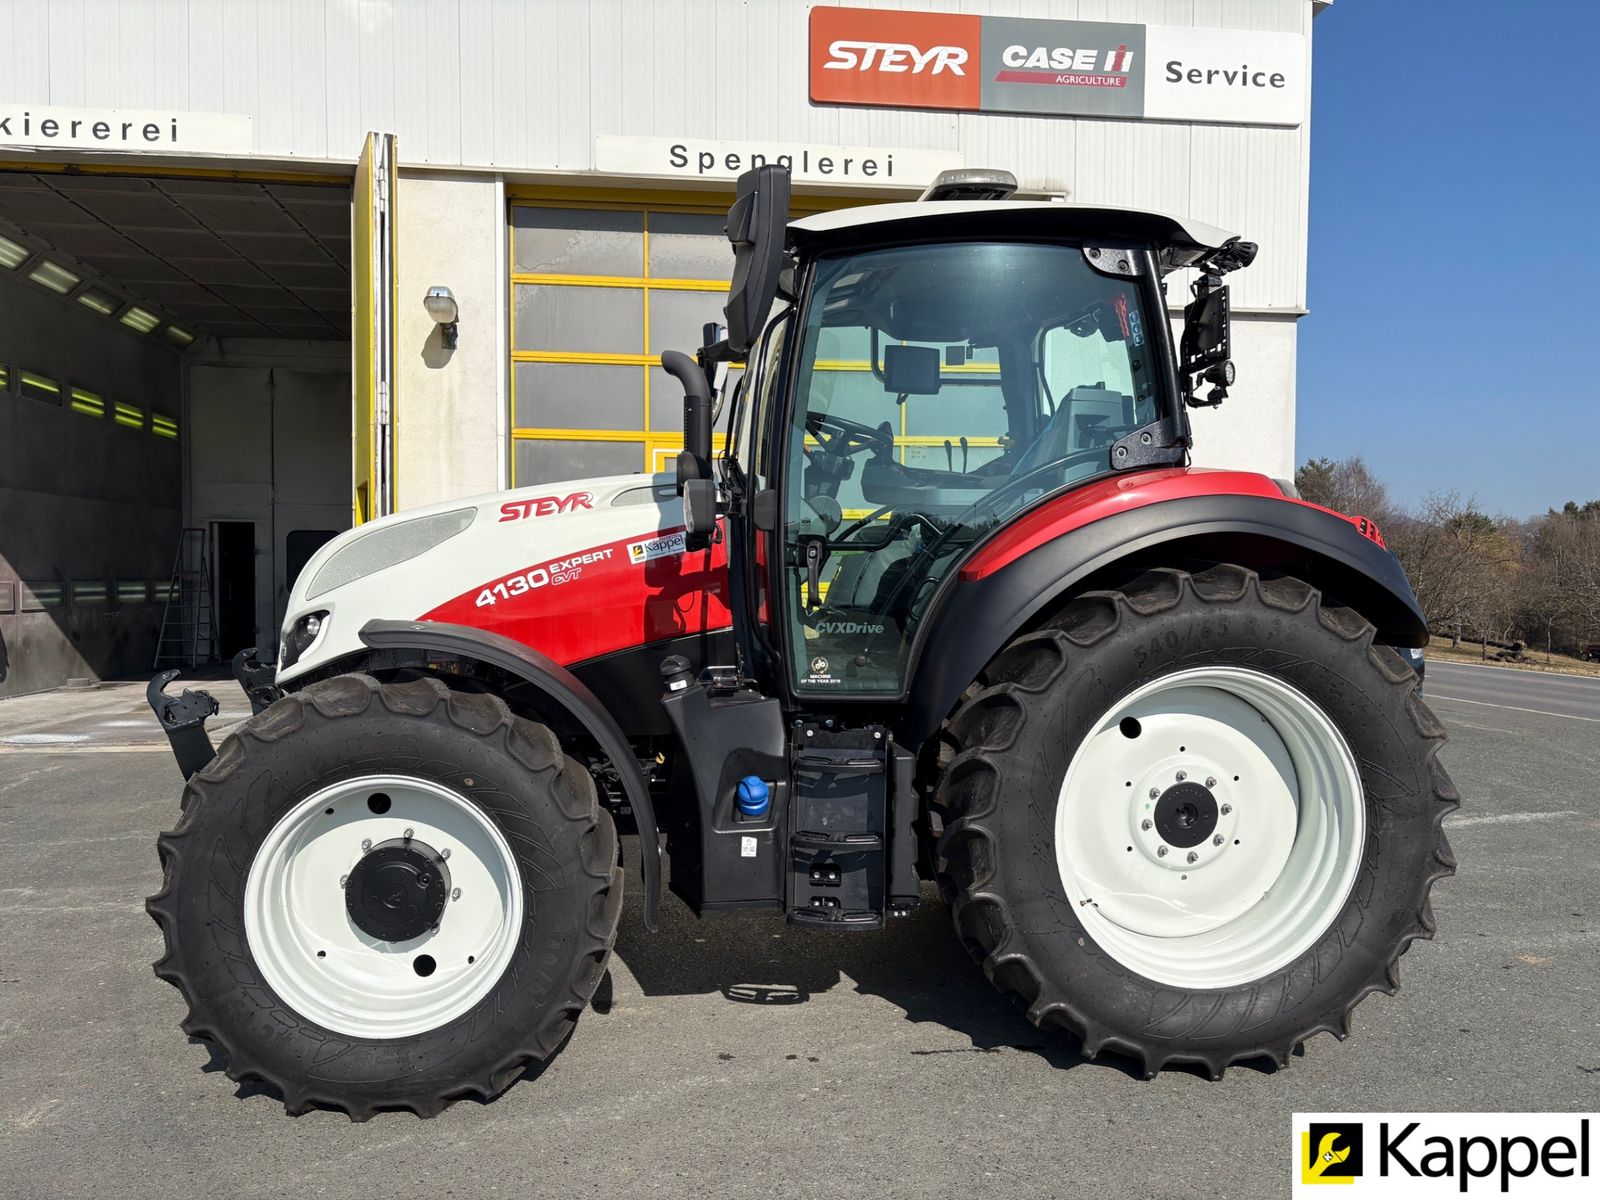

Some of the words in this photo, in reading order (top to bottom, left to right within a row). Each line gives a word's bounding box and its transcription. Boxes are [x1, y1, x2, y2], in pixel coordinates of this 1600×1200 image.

[823, 40, 969, 76] STEYR
[1002, 44, 1098, 71] CASE
[1055, 74, 1121, 87] AGRICULTURE
[1165, 61, 1286, 89] Service
[499, 491, 594, 523] STEYR
[644, 534, 684, 554] Kappel
[550, 549, 613, 574] EXPERT
[475, 568, 550, 608] 4130
[551, 568, 582, 586] CVT
[816, 622, 885, 634] CVXDrive
